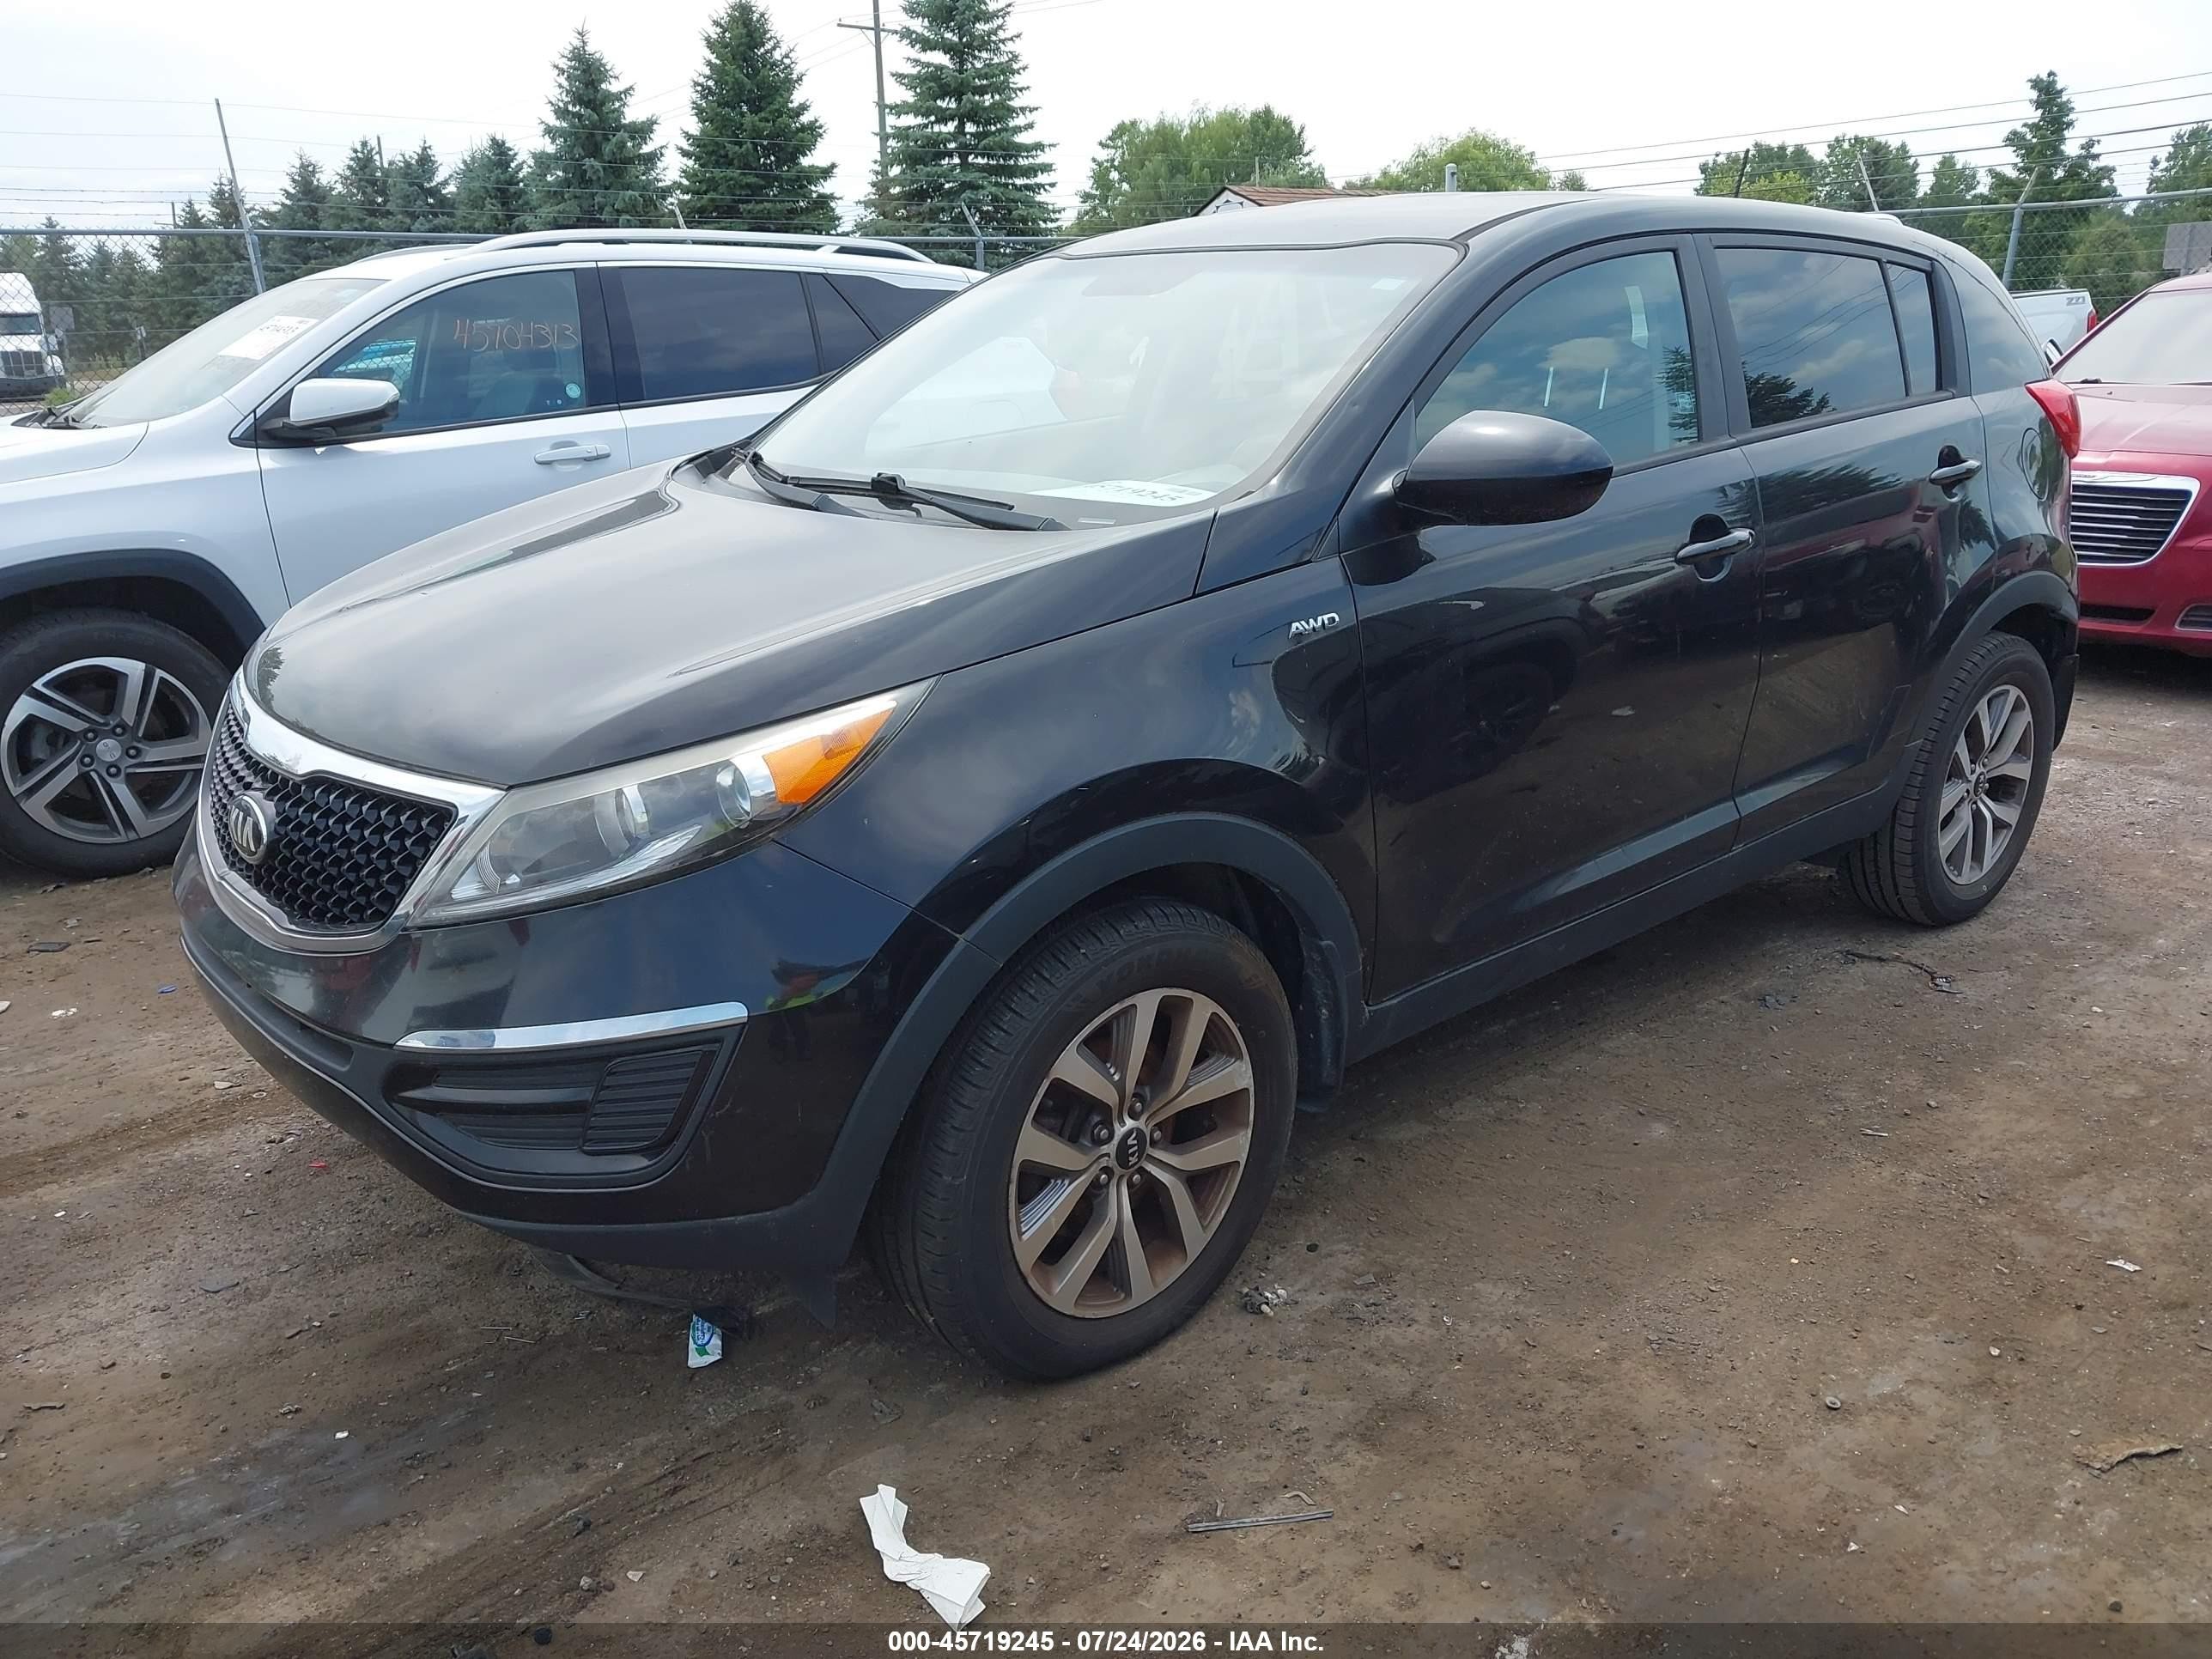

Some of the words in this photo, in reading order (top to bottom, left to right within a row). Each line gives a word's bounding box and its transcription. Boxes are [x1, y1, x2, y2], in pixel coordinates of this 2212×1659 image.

[453, 319, 578, 352] 45704313
[1288, 612, 1340, 639] AWD
[229, 805, 256, 852] KIA
[1127, 1128, 1139, 1166] KIA
